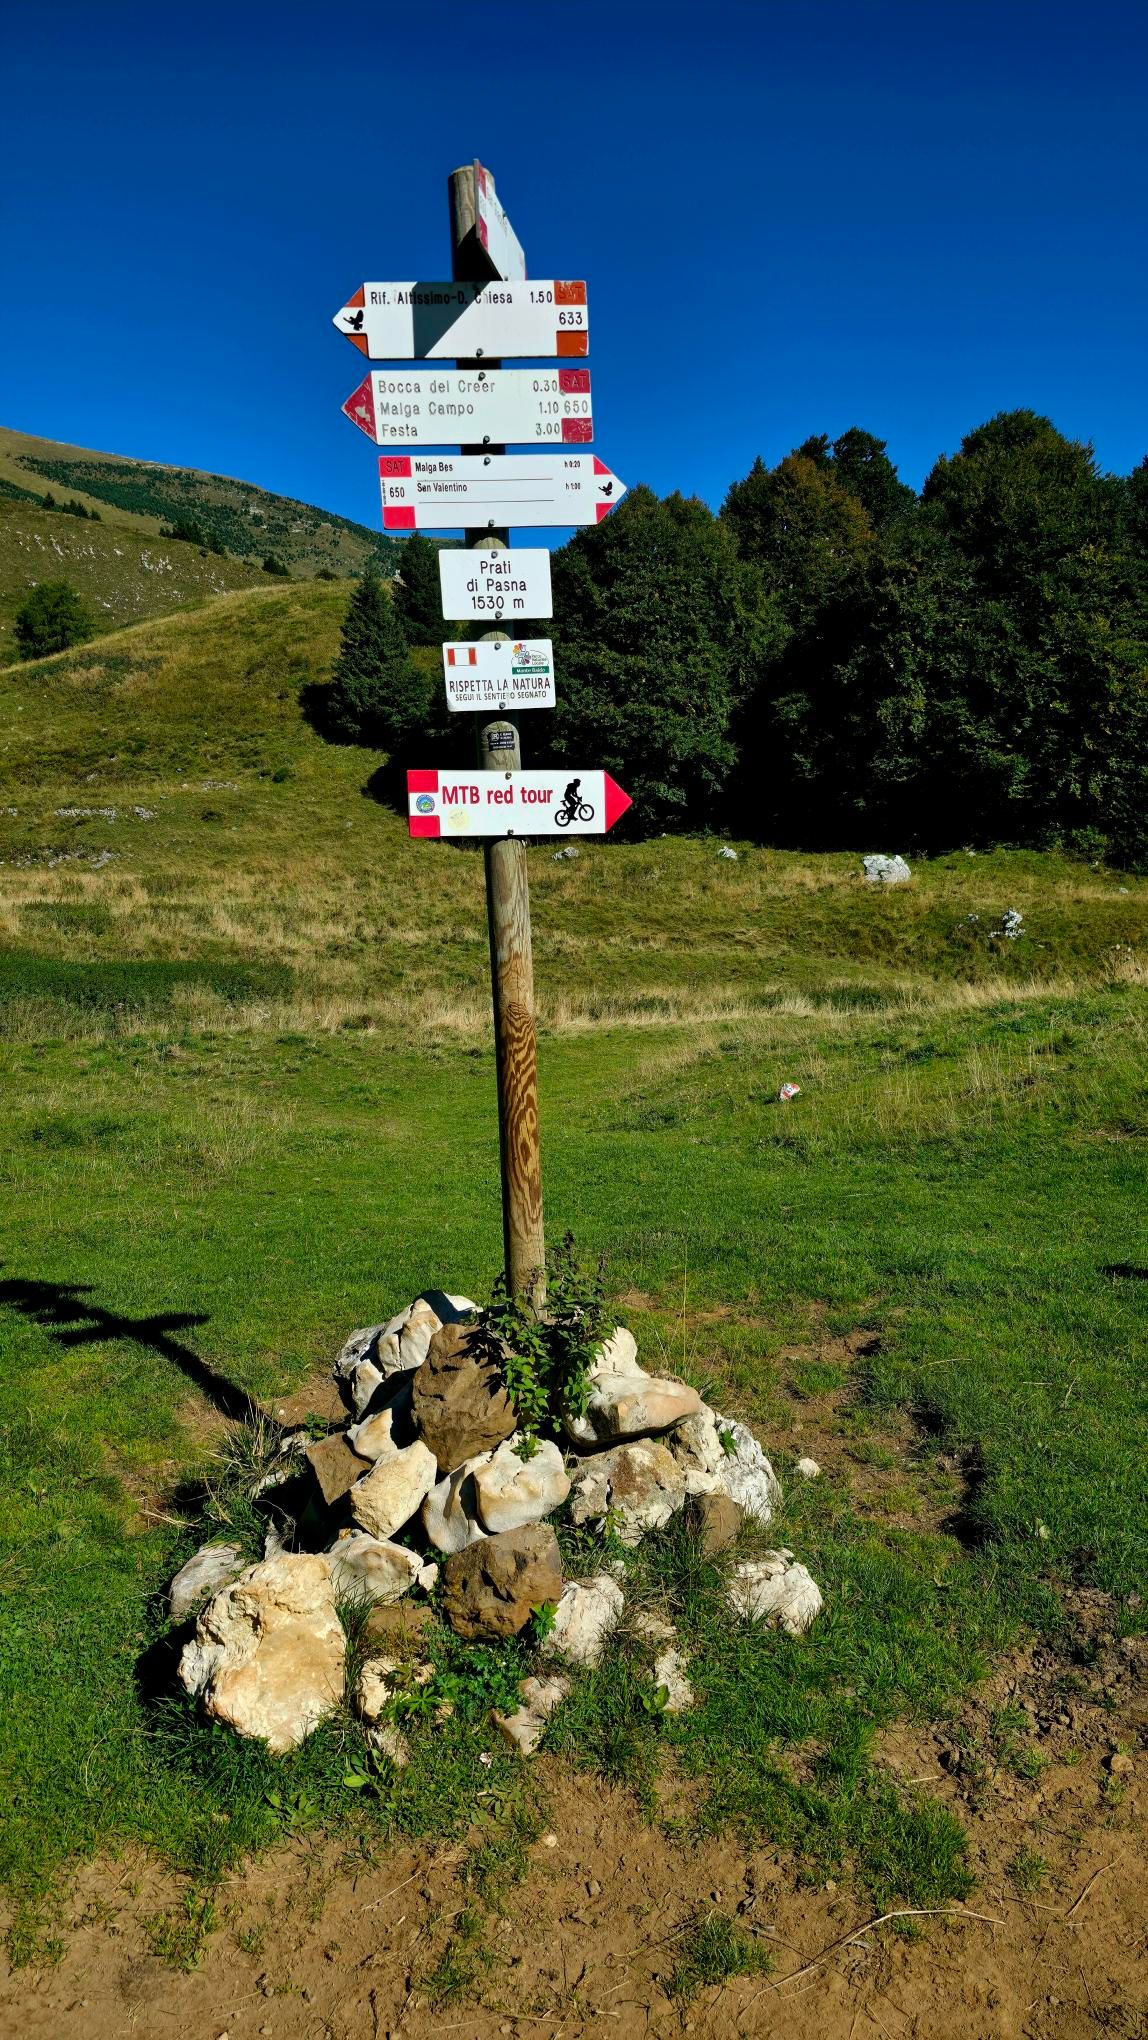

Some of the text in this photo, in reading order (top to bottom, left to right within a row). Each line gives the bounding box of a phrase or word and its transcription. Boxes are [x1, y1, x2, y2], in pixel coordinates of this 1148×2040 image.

[371, 291, 390, 305] Rif.
[529, 290, 553, 304] 1.50
[558, 285, 583, 300] SAT
[558, 311, 583, 325] 633
[378, 379, 558, 393] Bocca del Creer 0.30
[562, 374, 587, 389] SAT
[380, 401, 559, 418] Malga Campo 1.10
[564, 400, 588, 414] 650
[381, 422, 560, 437] Festa 3.00
[386, 461, 404, 473] SAT
[415, 462, 437, 474] Malga
[438, 462, 453, 472] Bes
[389, 486, 405, 498] 650
[416, 482, 432, 492] San
[433, 482, 468, 492] Valentino
[480, 560, 511, 574] Prati
[466, 578, 527, 592] di Pasna
[471, 596, 525, 609] 1530 m
[449, 677, 551, 692] RISPETTA LA NATURA
[455, 693, 475, 701] SEGUI
[484, 692, 515, 700] SENTIEO
[518, 690, 547, 699] SEGNATO
[442, 785, 481, 805] MTB
[486, 784, 514, 804] red
[520, 786, 553, 804] tour
